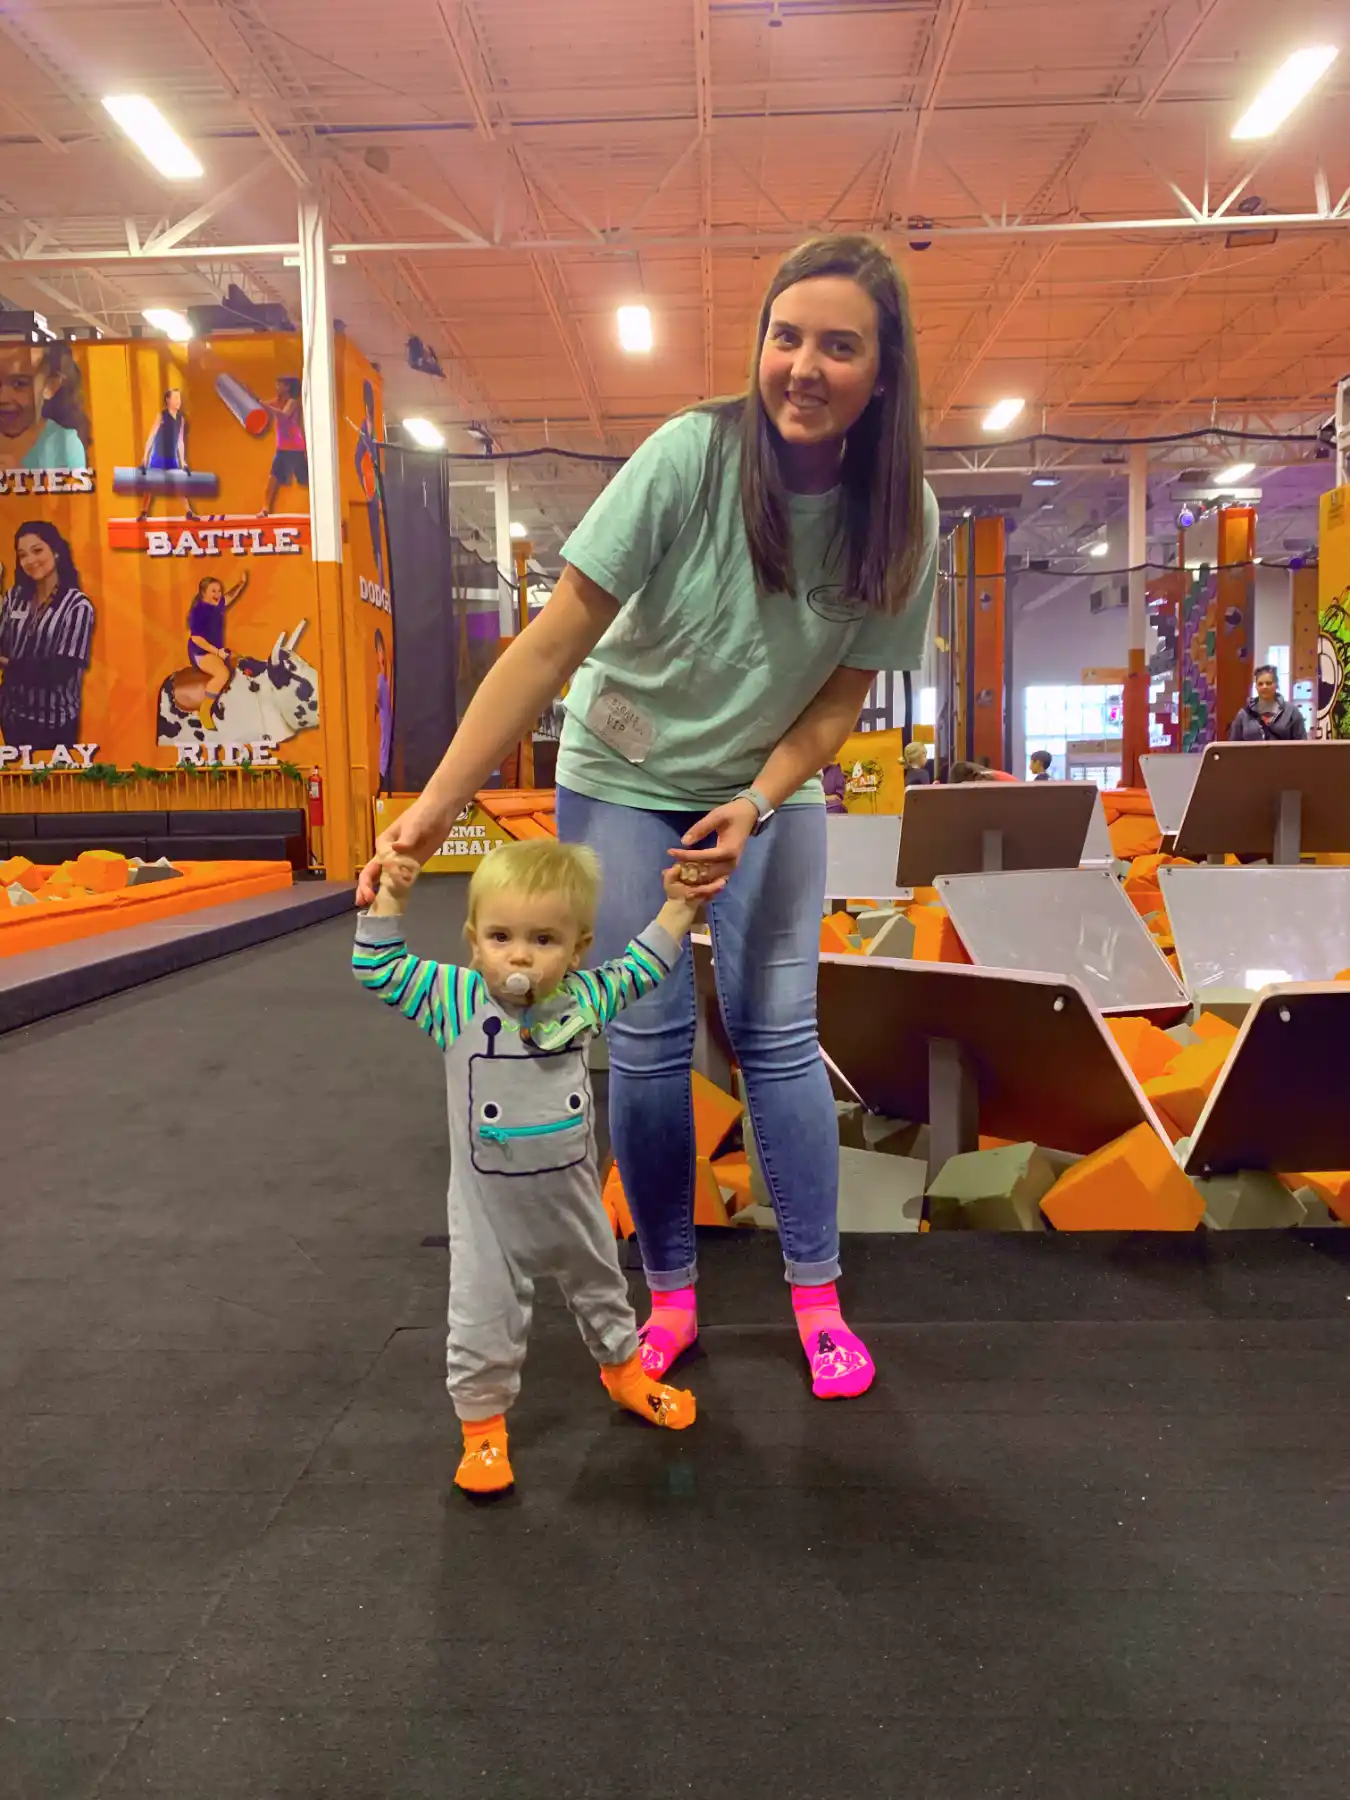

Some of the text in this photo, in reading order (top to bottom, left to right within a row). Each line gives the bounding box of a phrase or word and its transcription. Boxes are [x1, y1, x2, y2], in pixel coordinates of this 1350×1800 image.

[145, 528, 301, 556] BATTLE
[606, 713, 626, 731] VIP
[0, 743, 98, 770] PLAY
[175, 741, 279, 767] RIDE
[448, 825, 486, 838] EME
[433, 839, 504, 856] EBAL
